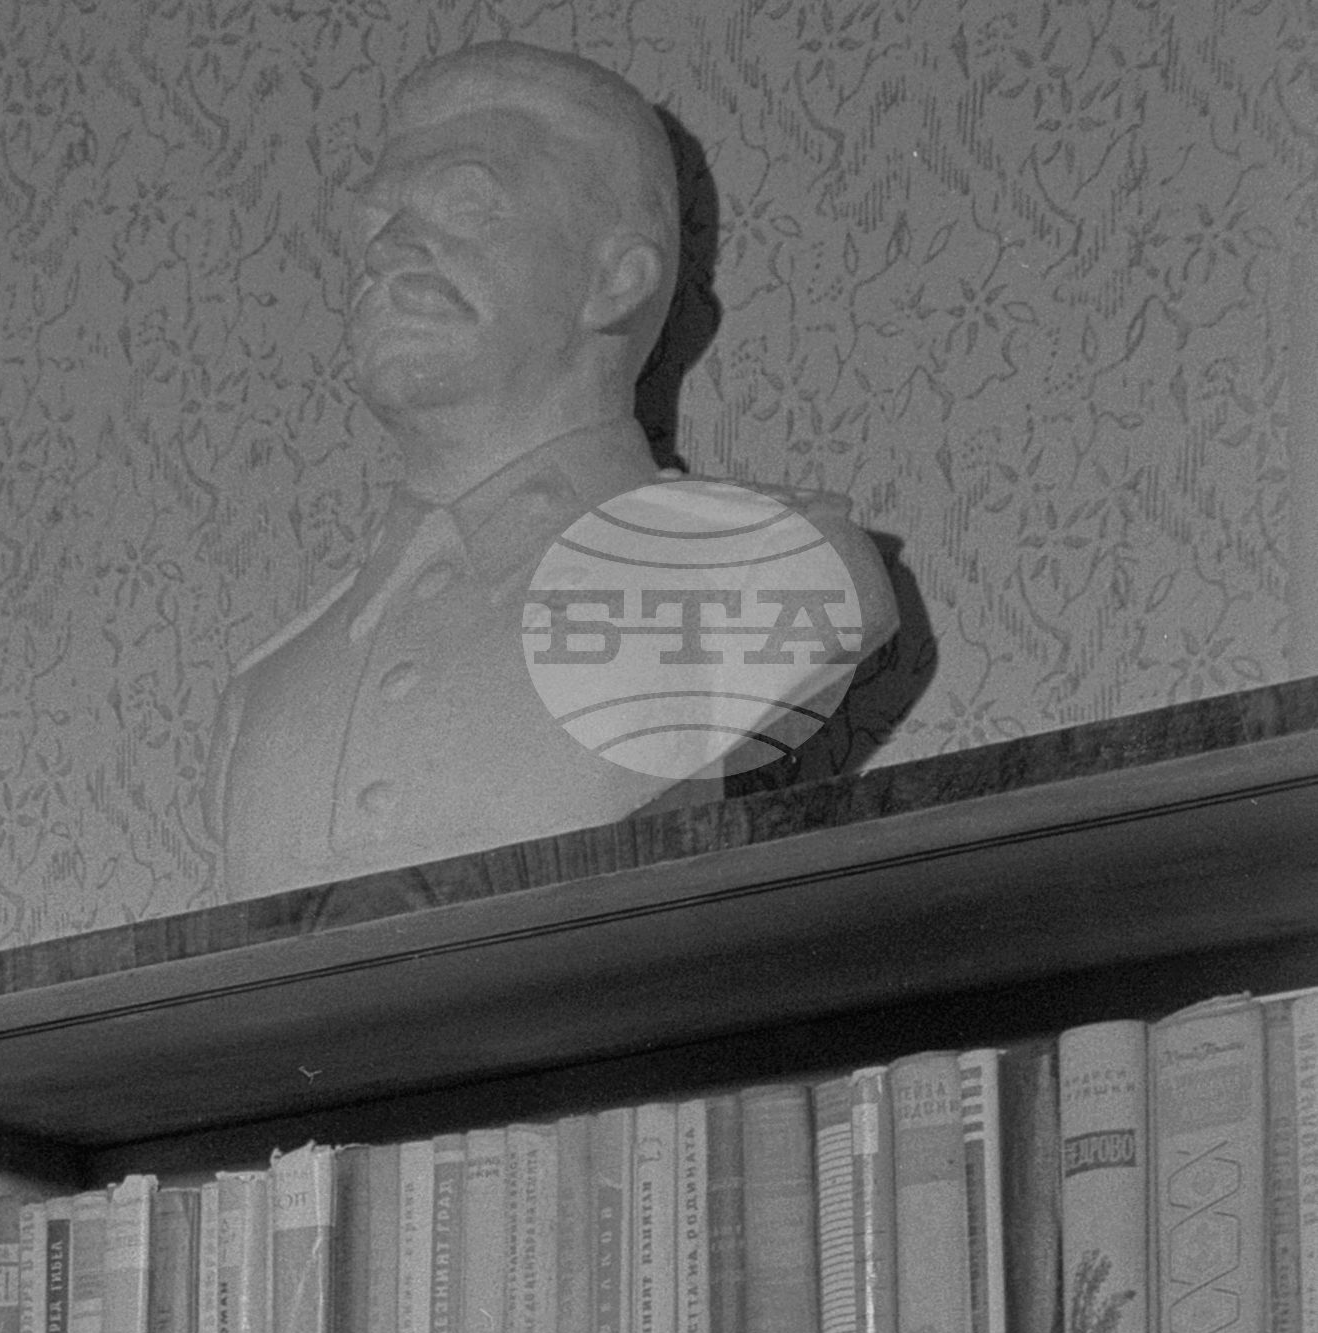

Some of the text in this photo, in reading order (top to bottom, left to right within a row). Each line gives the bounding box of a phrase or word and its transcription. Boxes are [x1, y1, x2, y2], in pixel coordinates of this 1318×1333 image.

[436, 1178, 454, 1232] ГРАД
[684, 1127, 698, 1240] РОДИНАТА
[50, 1239, 64, 1291] ГИБЕЛ
[686, 1251, 699, 1276] НА
